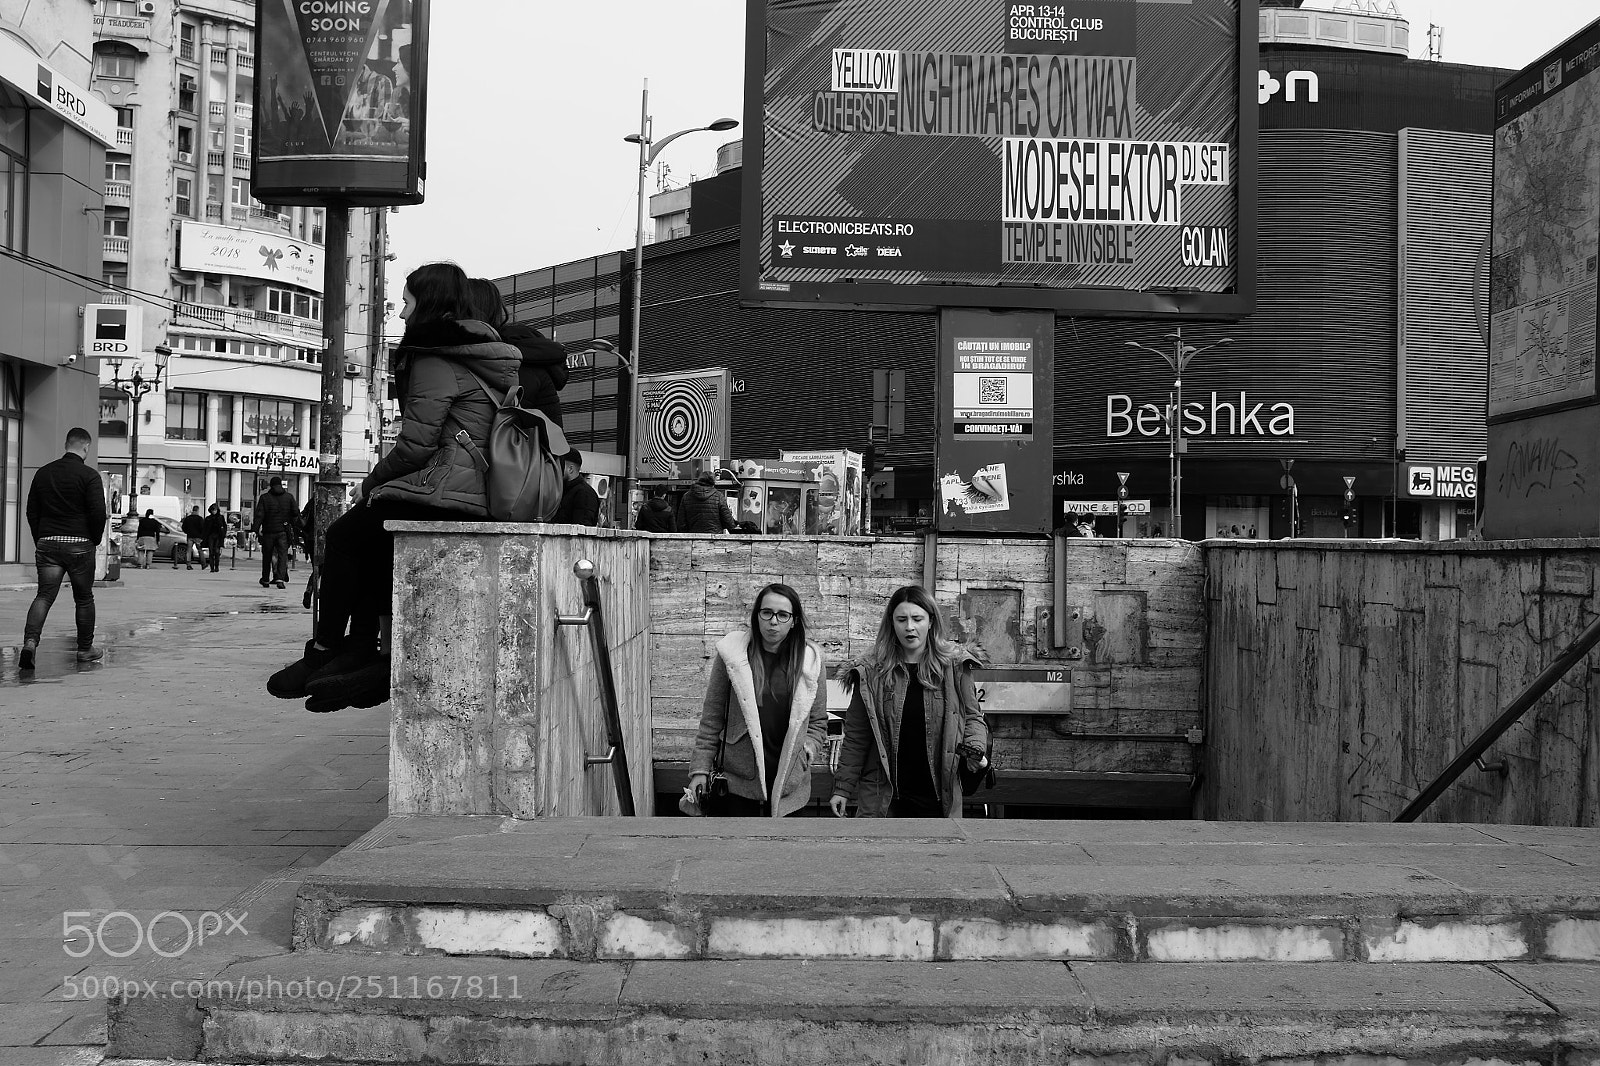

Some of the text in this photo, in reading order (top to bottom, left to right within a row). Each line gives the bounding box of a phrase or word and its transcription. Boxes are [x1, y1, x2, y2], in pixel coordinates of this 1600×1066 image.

[300, 1, 371, 14] COMING
[1010, 5, 1065, 17] APR 13-14
[311, 18, 360, 31] SOON
[1010, 17, 1103, 30] CONTROL CLUB
[1010, 29, 1078, 43] BUCUREȘTI
[1565, 41, 1600, 73] METRORE
[57, 85, 86, 117] BRD
[901, 52, 1133, 138] NIGHTMARES ON WAX
[814, 91, 896, 132] OTHERSIDE
[1005, 139, 1227, 223] MODESELEKTOR DJ SET
[778, 220, 914, 236] ELECTRONICBEATS.RO
[1004, 223, 1133, 264] TEMPLE INVISIBLE
[1181, 227, 1229, 267] GOLAN
[210, 246, 241, 259] 2018
[92, 341, 128, 353] BRD
[989, 342, 1000, 351] UN
[729, 377, 745, 392] ka
[1107, 391, 1295, 437] Bershka
[231, 451, 298, 468] Raiffeisen
[1068, 503, 1146, 512] WINE & FOD
[1047, 671, 1063, 682] M2
